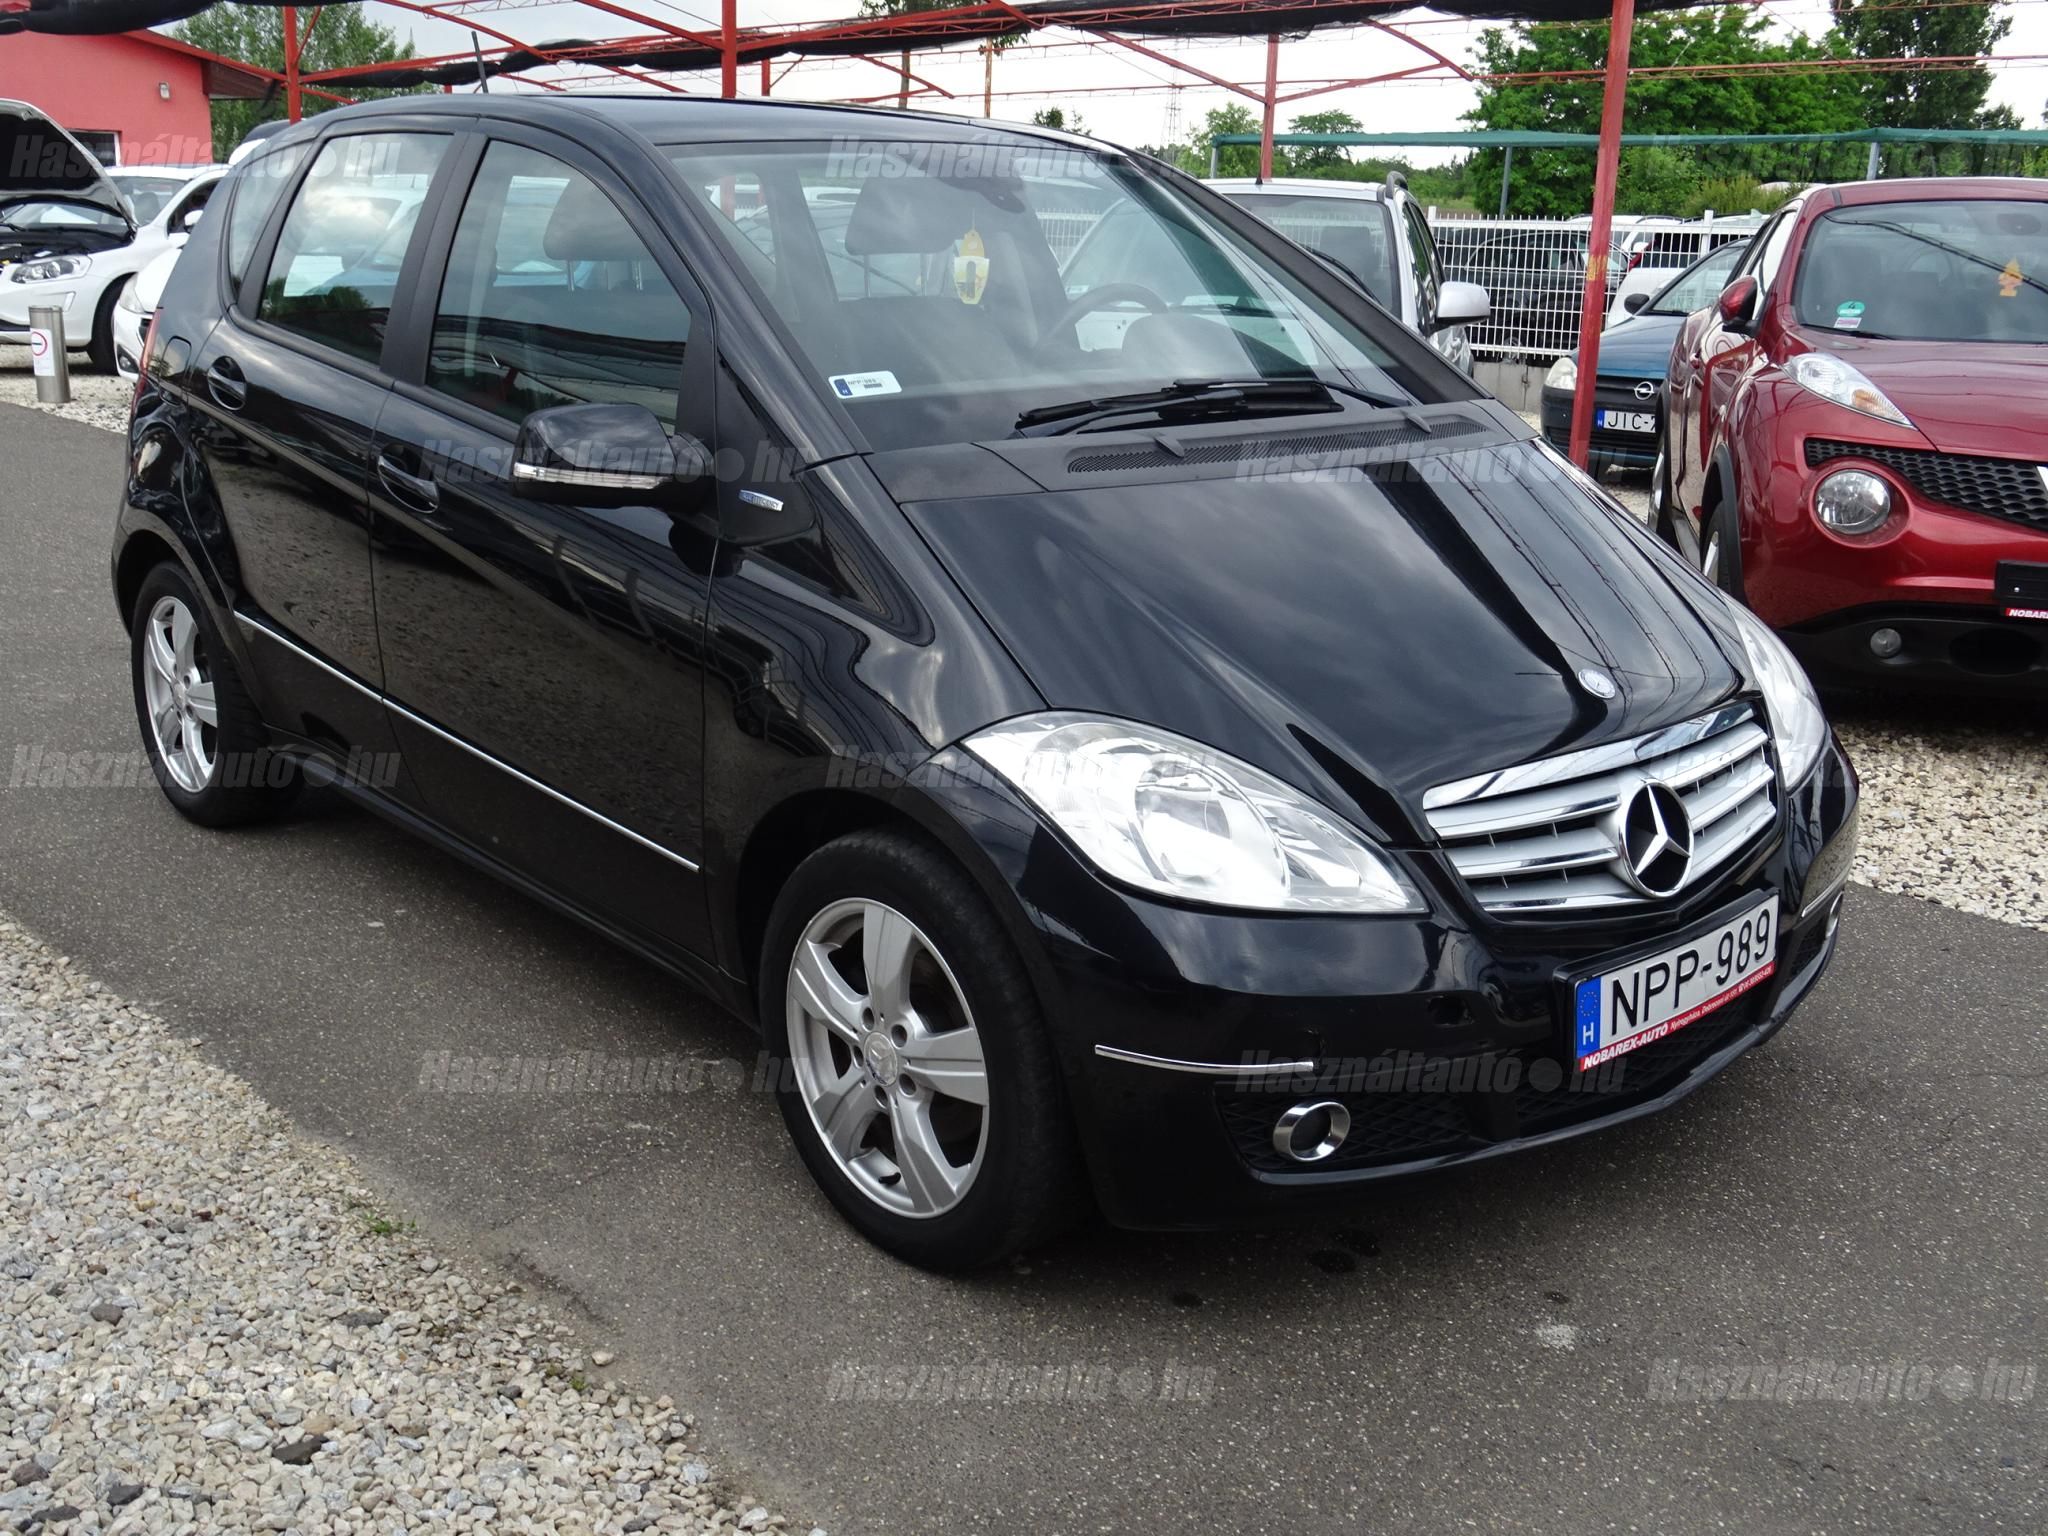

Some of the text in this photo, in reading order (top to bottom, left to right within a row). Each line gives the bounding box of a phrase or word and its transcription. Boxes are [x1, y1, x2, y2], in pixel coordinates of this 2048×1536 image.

[1612, 909, 1771, 1036] NPP-989
[1583, 1022, 1594, 1045] H
[1583, 1022, 1669, 1070] NOBAREX-AUTÓ
